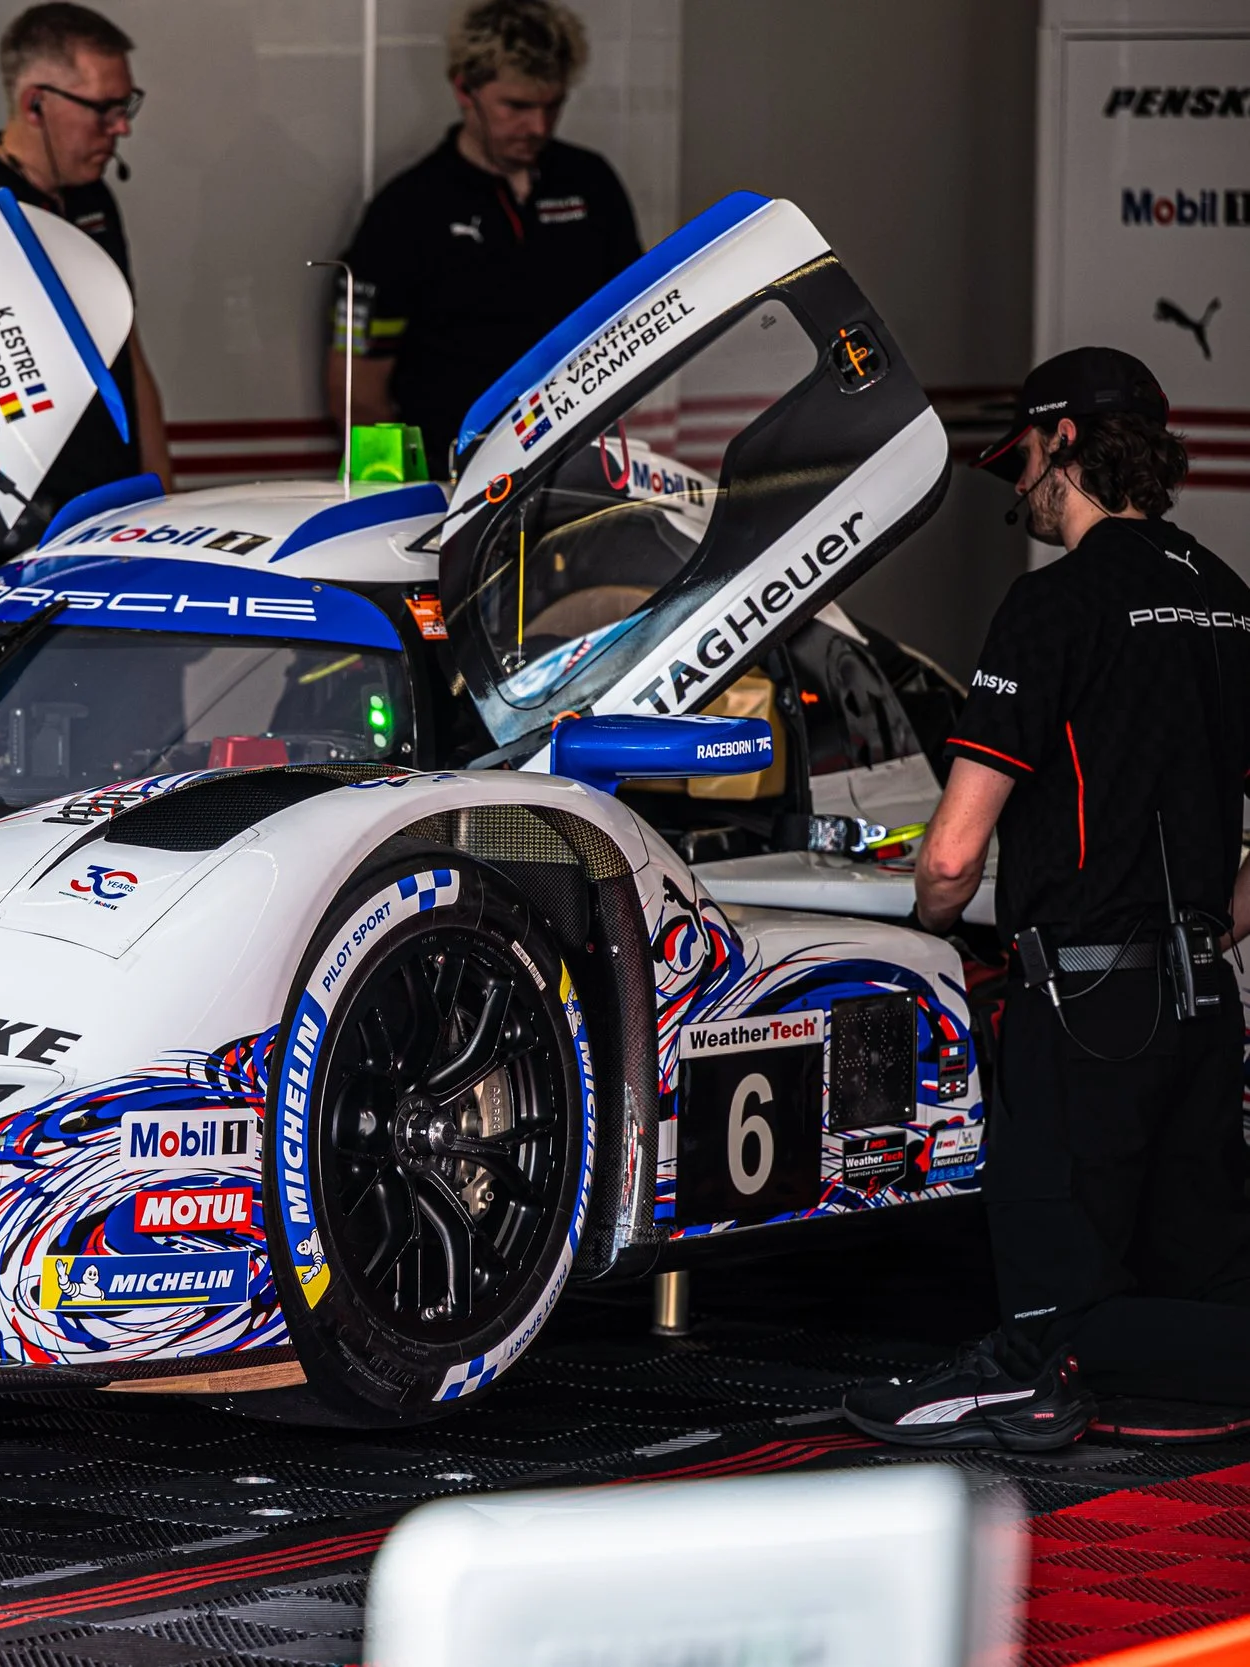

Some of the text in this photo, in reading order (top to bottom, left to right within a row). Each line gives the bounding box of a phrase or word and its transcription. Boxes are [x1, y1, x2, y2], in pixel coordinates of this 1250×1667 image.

[1103, 87, 1250, 118] PENSK
[1121, 189, 1217, 226] Mobil
[0, 326, 41, 382] ESTRE
[547, 288, 682, 405] L. VANTHOOR
[554, 302, 696, 420] M. CAMPBELL
[632, 460, 685, 500] Mobil
[65, 524, 218, 545] Mobil
[696, 740, 751, 759] RACEBORN
[106, 880, 136, 893] YEARS
[322, 901, 391, 993] PILOT SPORT
[689, 1018, 815, 1049] WeatherTech
[278, 1014, 321, 1224] MICHELIN
[727, 1073, 775, 1195] 6
[130, 1120, 248, 1159] Mobil 1
[574, 1041, 597, 1240] MICHELIN
[845, 1151, 904, 1168] WeatherTech
[140, 1192, 249, 1227] MOTUL
[109, 1269, 235, 1293] MICHELIN
[507, 1264, 567, 1360] PILOT SPORT
